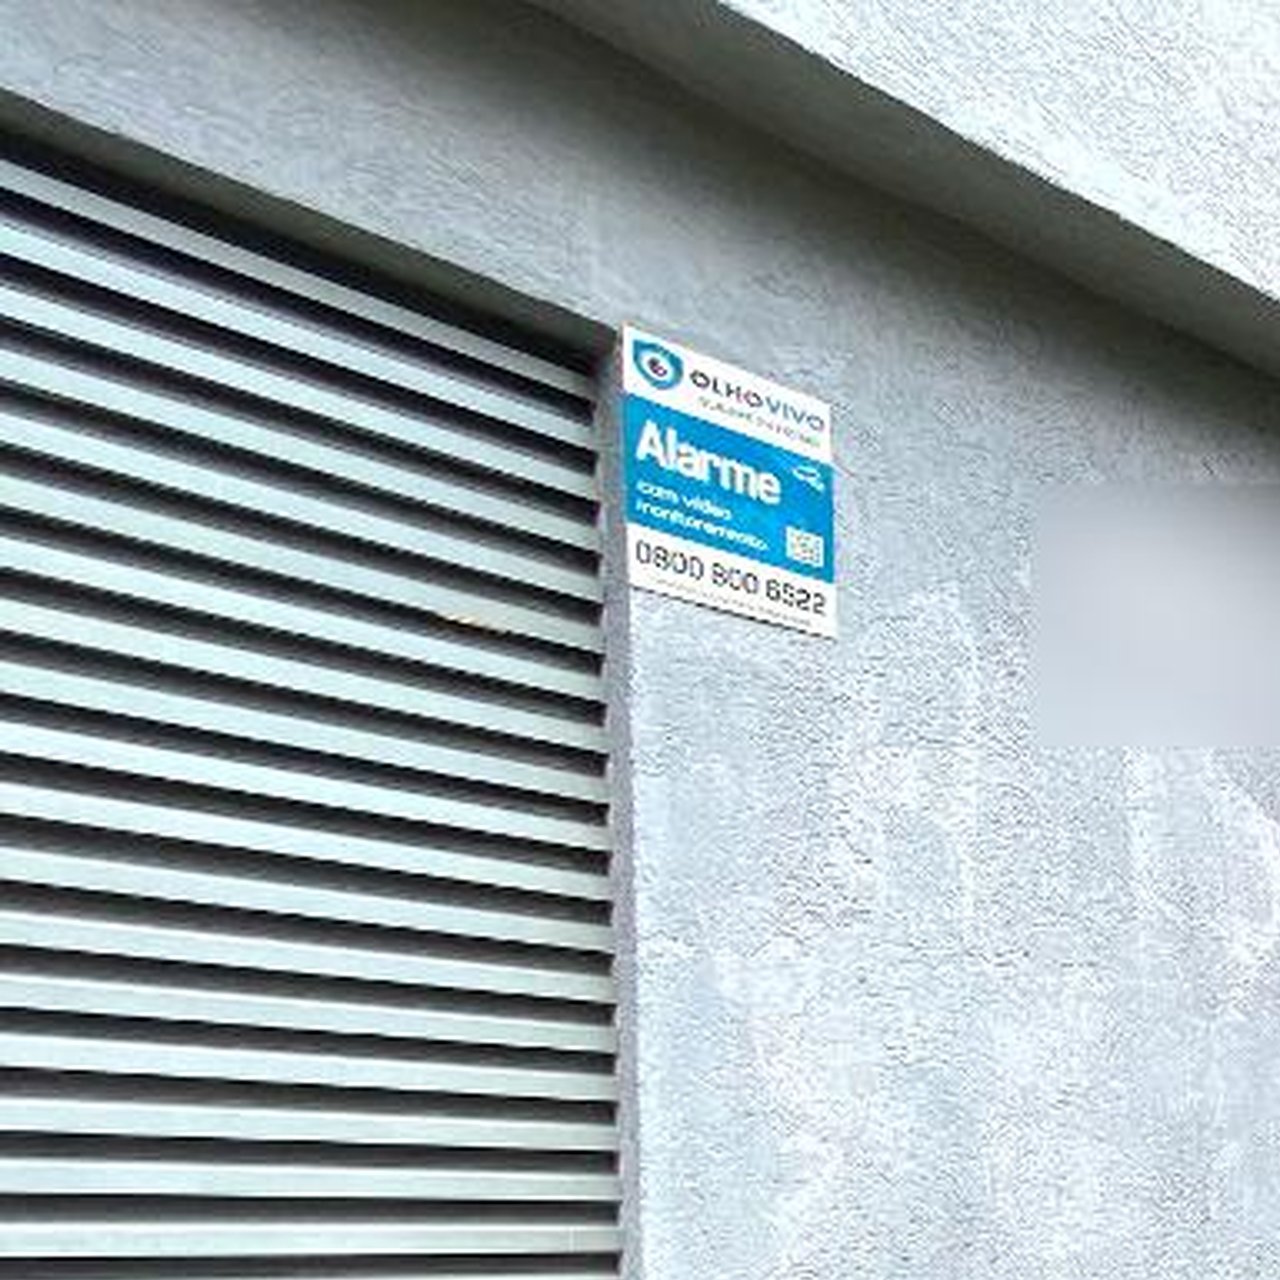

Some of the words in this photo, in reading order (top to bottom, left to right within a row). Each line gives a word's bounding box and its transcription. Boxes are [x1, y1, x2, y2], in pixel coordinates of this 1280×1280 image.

[635, 419, 782, 505] Alarme
[636, 481, 680, 504] com
[636, 540, 704, 580] 0800
[766, 579, 827, 615] 6522
